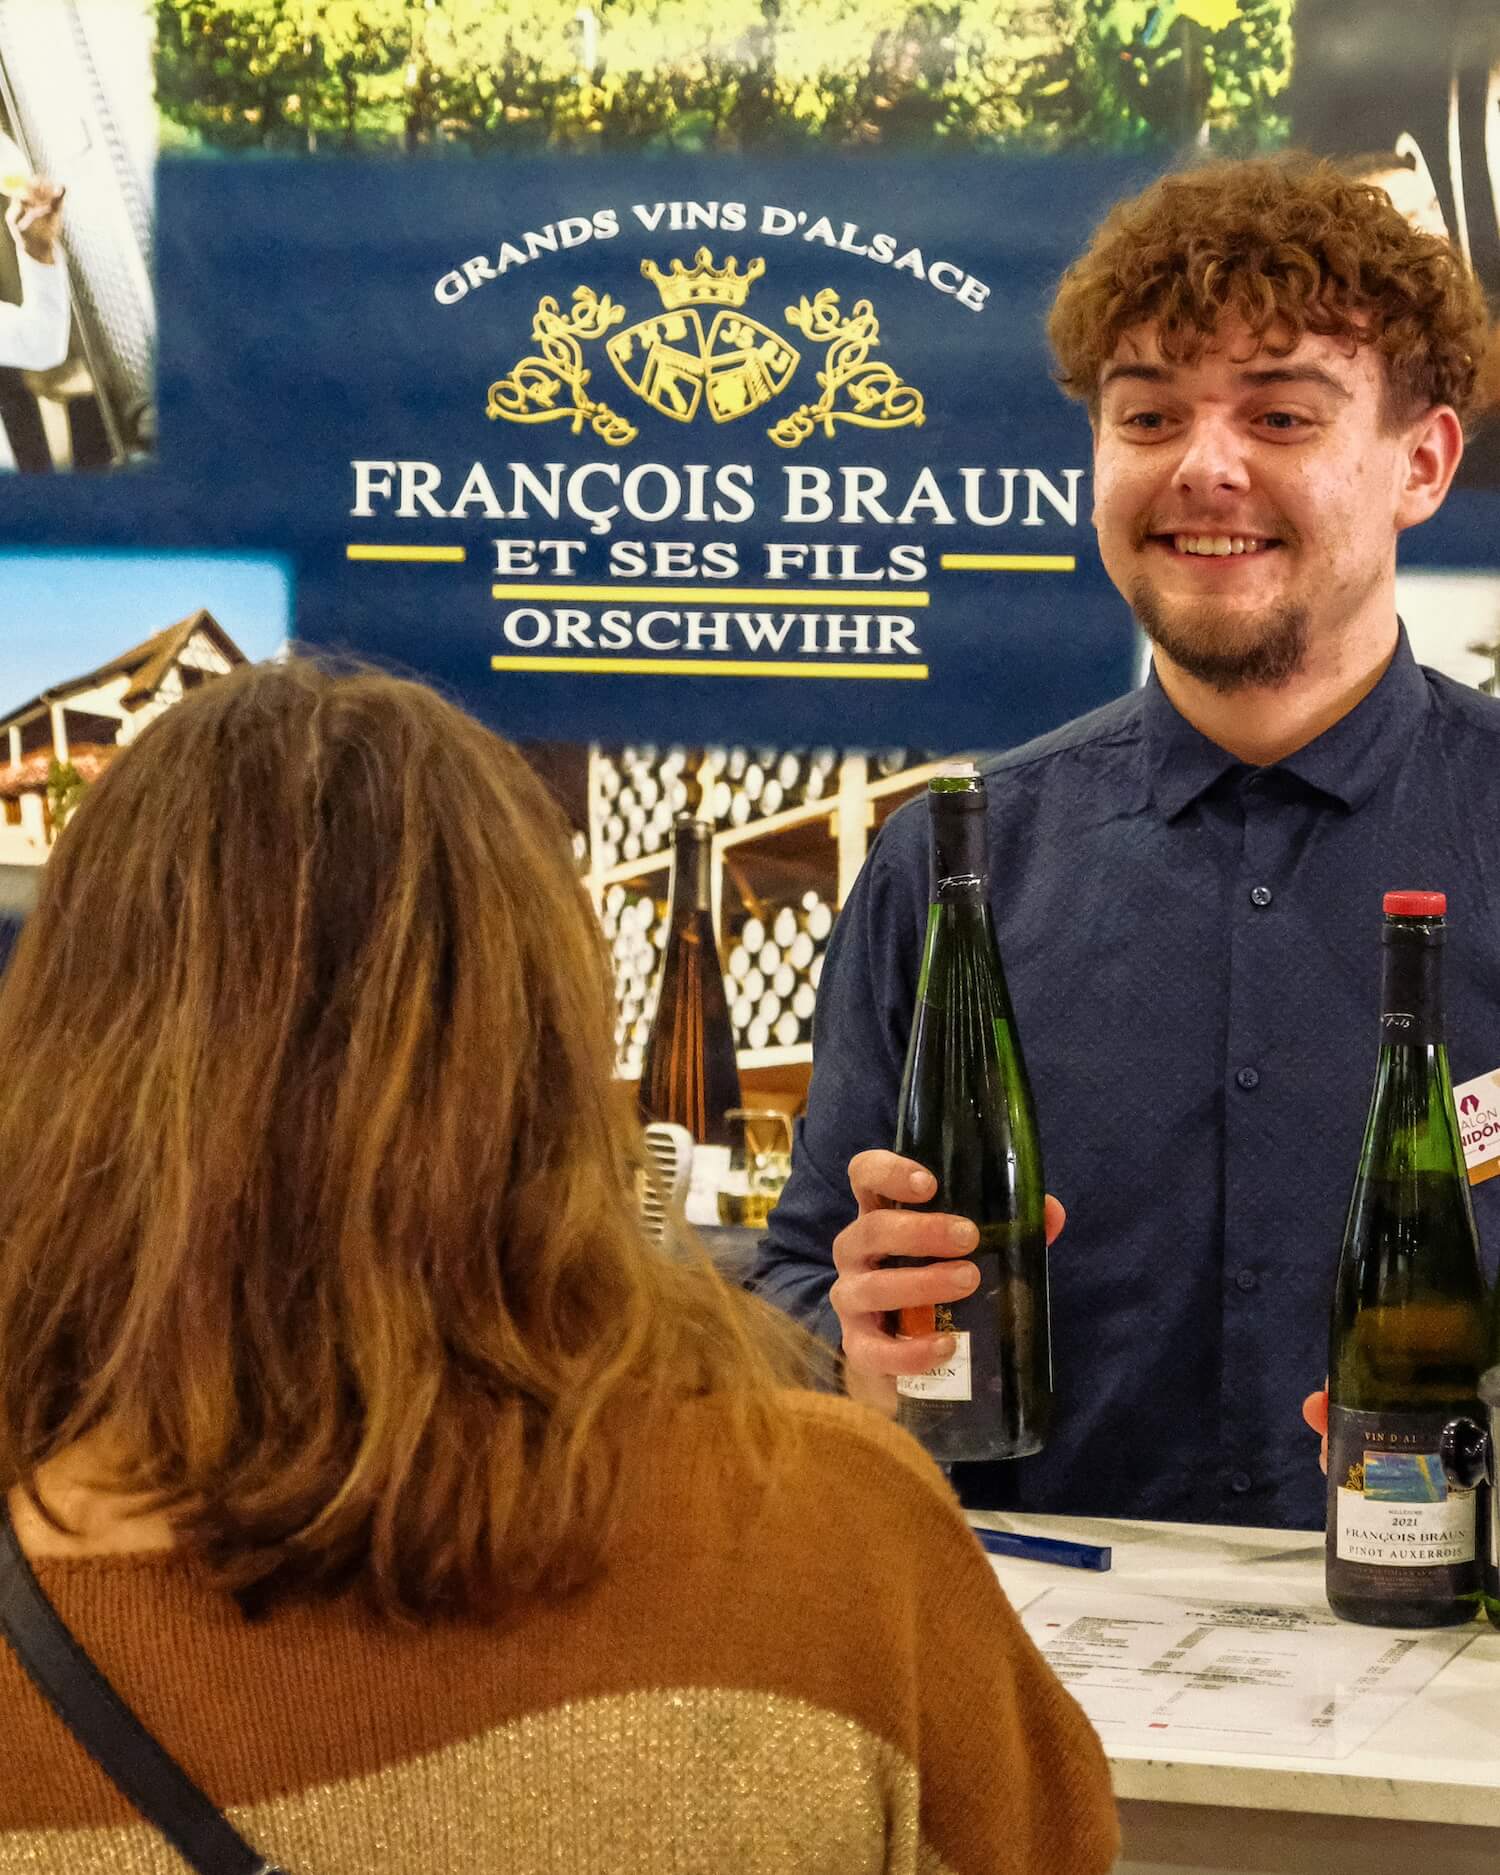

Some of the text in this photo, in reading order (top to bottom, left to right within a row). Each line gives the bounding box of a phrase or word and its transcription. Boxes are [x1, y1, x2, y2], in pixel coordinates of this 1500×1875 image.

[434, 200, 992, 313] GRANDS VINS D'ALSACE
[350, 460, 1086, 535] FRANÇOIS BRAUN
[493, 538, 929, 583] ET SES FILS
[503, 607, 923, 656] ORSCHWIHR
[1460, 1106, 1498, 1130] ALON
[1364, 1431, 1385, 1441] VIN
[1391, 1517, 1418, 1528] 2021
[1345, 1527, 1466, 1543] FRANÇOIS BRAUN
[1348, 1545, 1464, 1560] PINOT AUXERROIS
